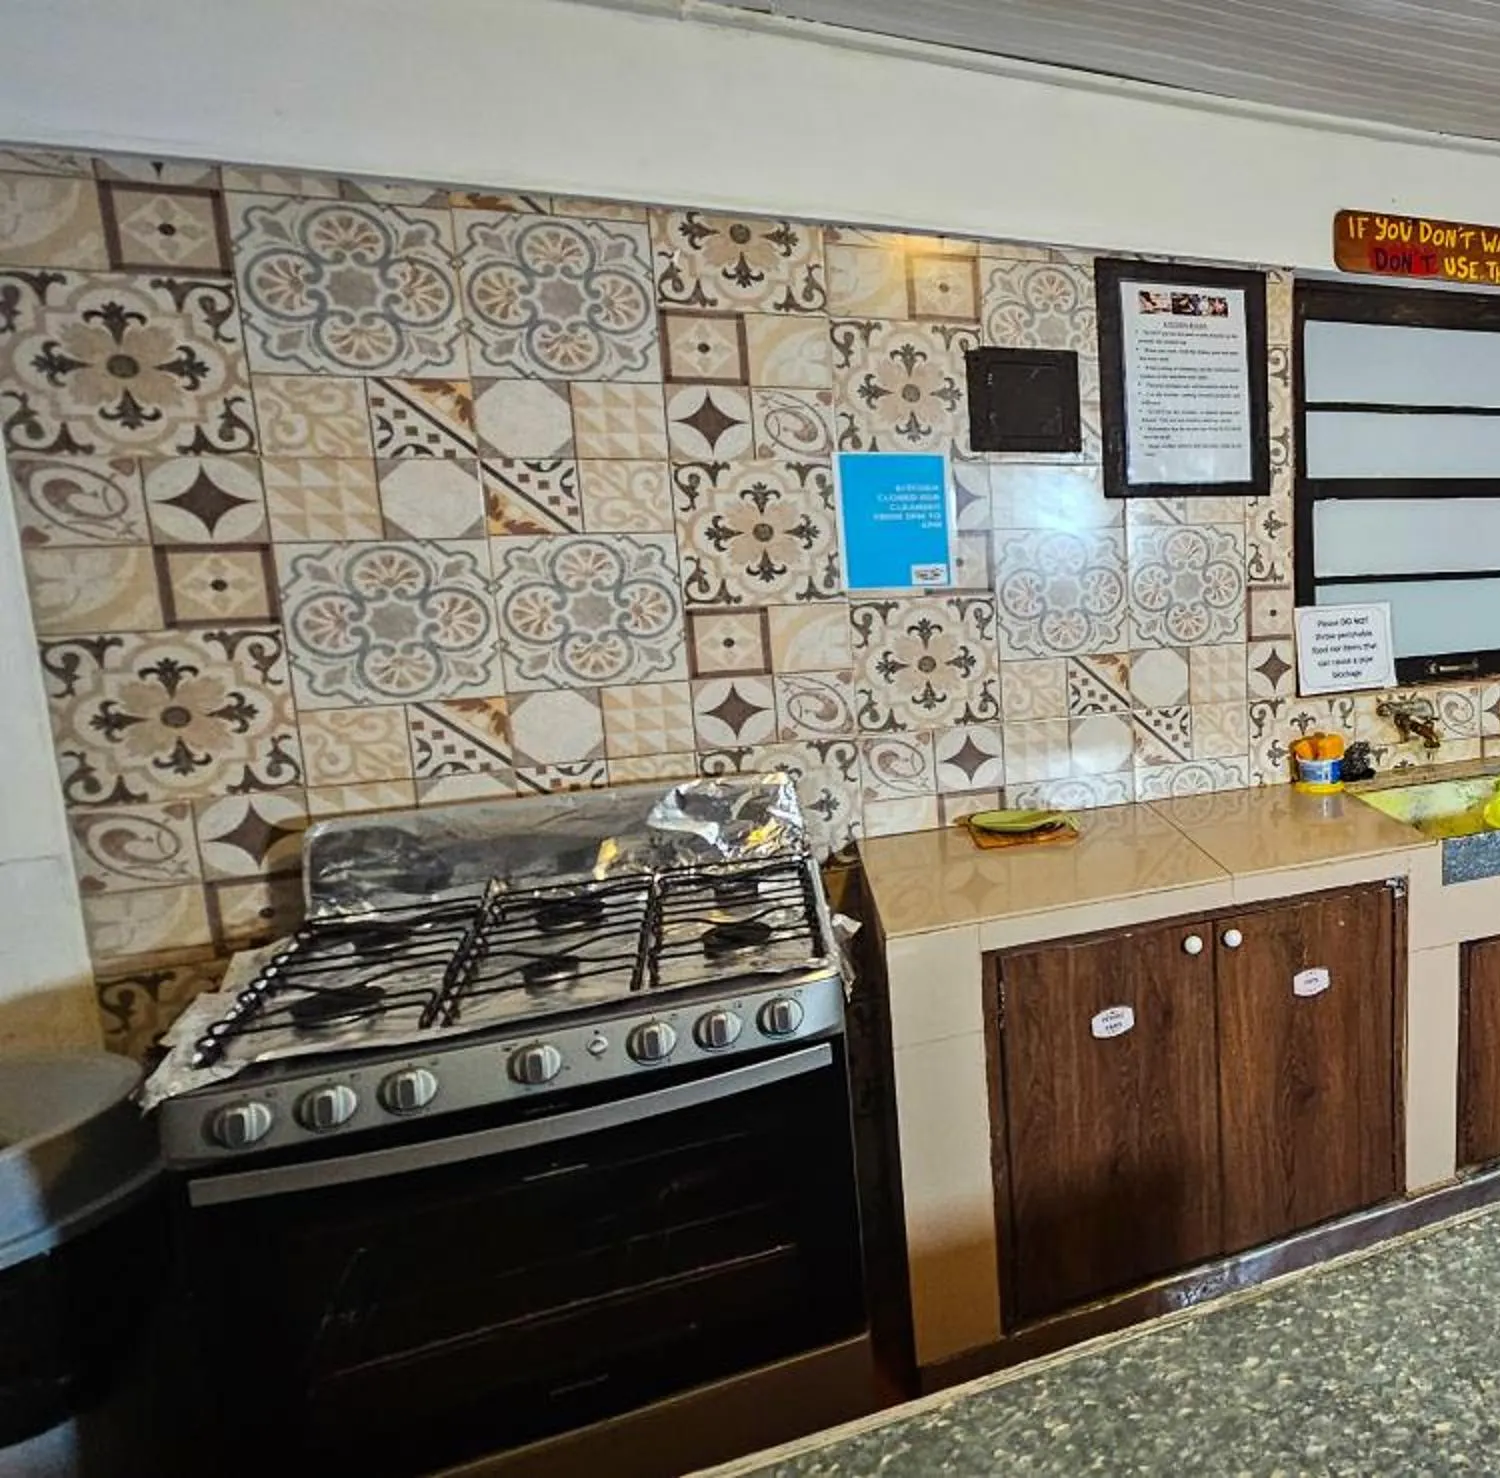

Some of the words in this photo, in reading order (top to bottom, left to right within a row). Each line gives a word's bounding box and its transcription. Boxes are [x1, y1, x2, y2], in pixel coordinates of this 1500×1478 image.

[1349, 216, 1369, 239] IF
[1375, 217, 1413, 242] YOU
[1419, 221, 1475, 249] DON'T
[1444, 256, 1479, 279] USE
